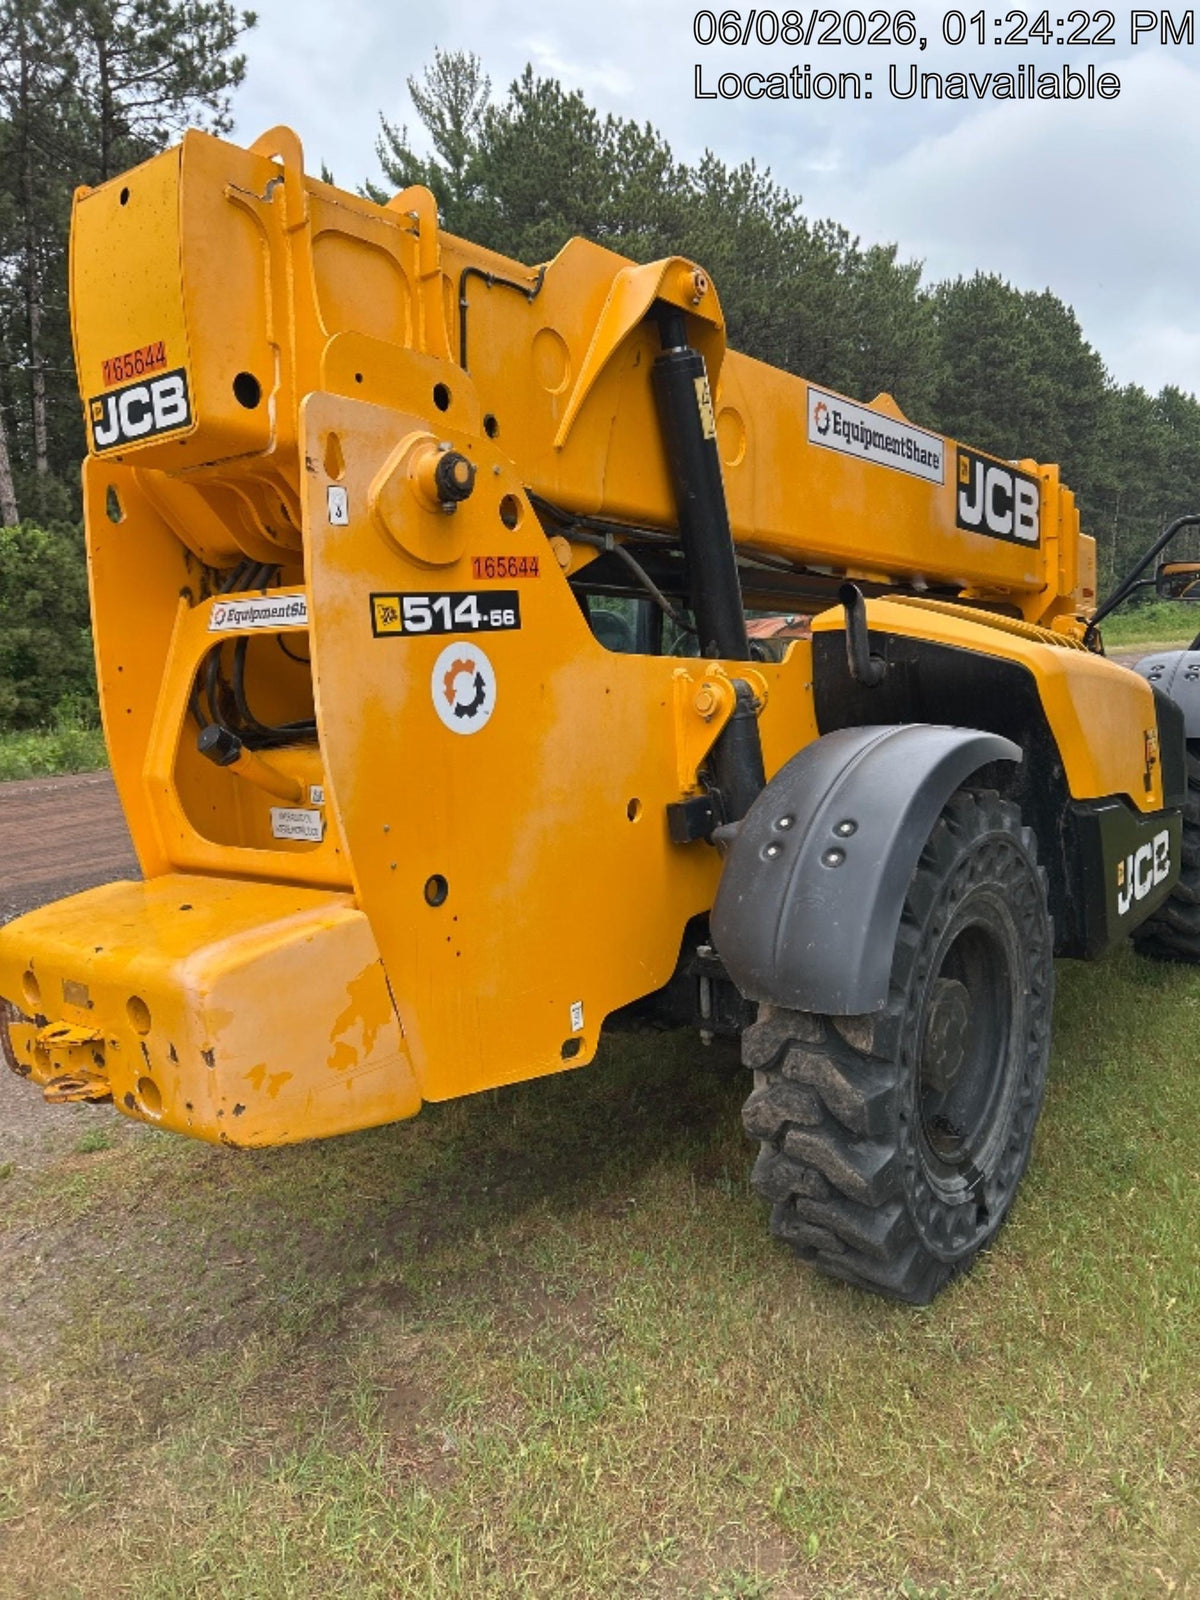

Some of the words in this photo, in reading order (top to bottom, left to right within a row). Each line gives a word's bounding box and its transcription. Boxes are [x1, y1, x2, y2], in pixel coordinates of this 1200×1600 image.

[103, 341, 166, 382] 165644
[94, 375, 188, 446] JCB
[831, 409, 940, 470] EquipmentShare
[958, 460, 1040, 542] JCB
[474, 556, 539, 578] 165644
[1117, 829, 1171, 915] JCB
